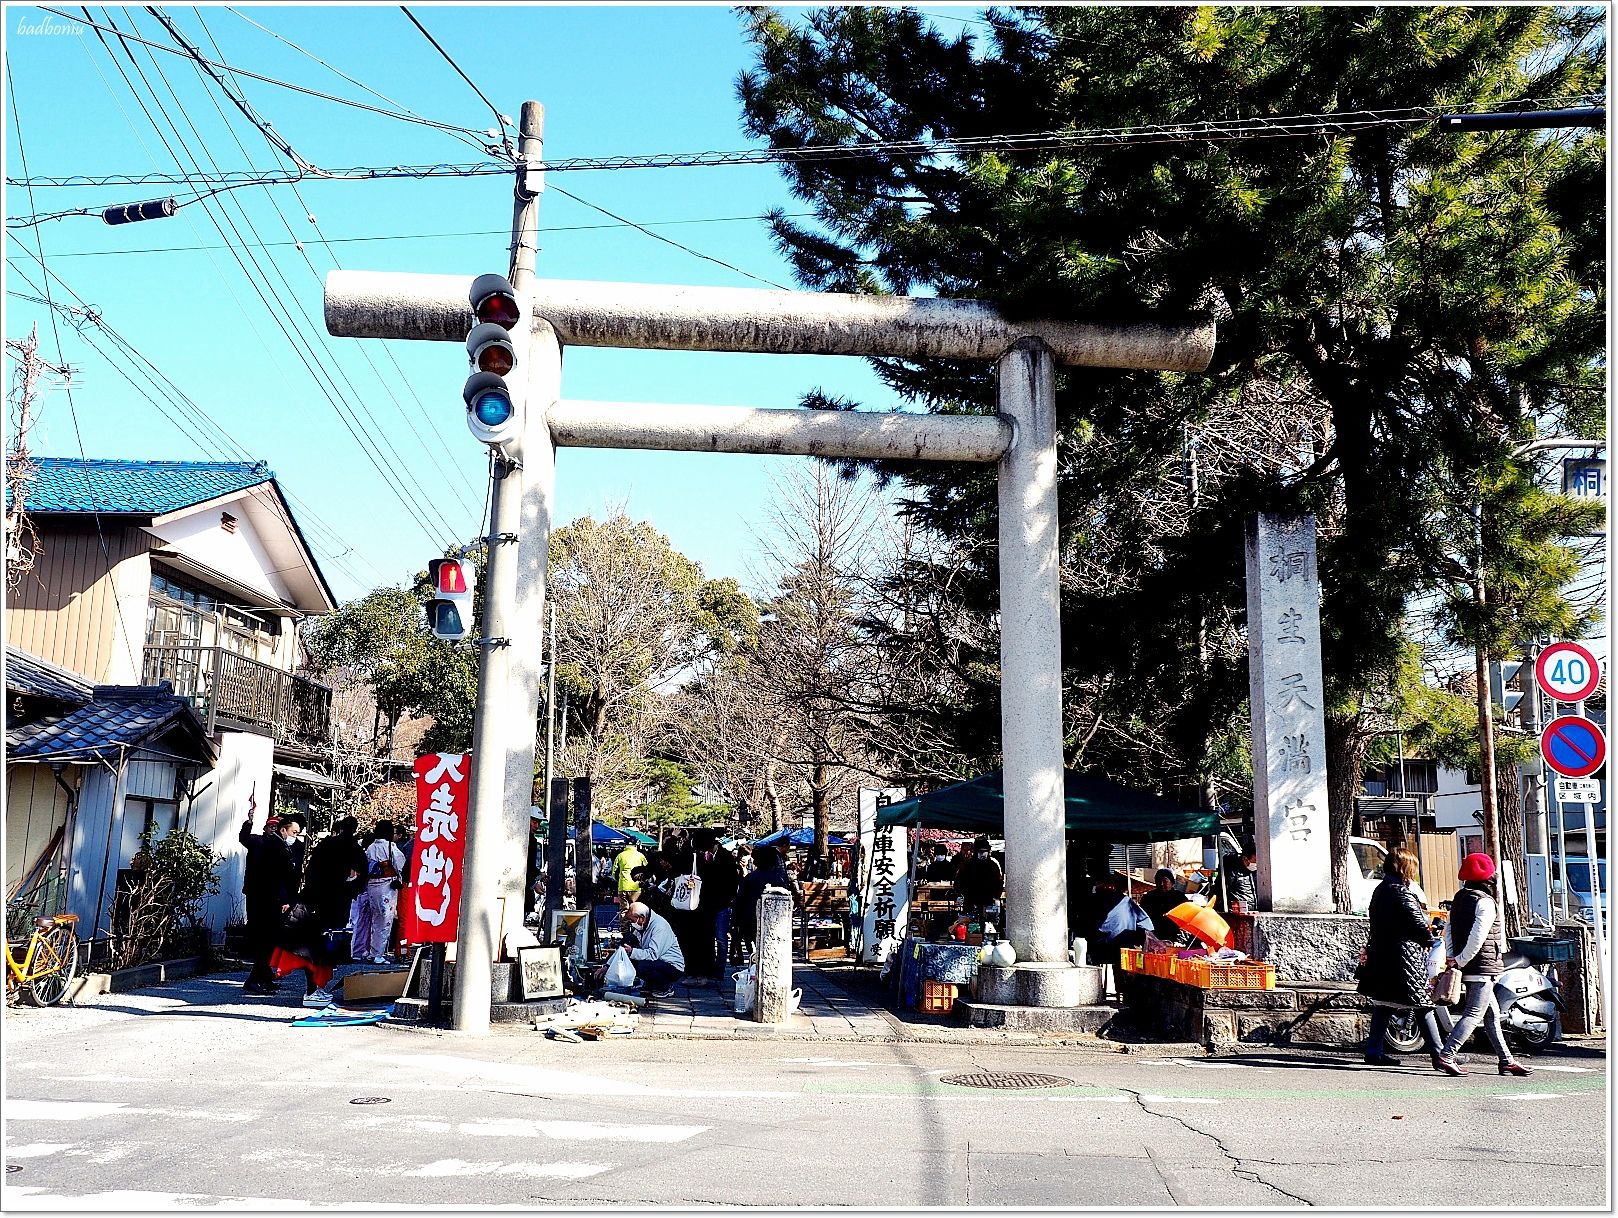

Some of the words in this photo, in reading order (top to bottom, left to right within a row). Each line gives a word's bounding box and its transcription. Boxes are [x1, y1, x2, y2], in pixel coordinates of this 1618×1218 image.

[1572, 467, 1606, 497] 桐
[1551, 659, 1585, 685] 40
[1269, 545, 1316, 843] 桐生天満宮
